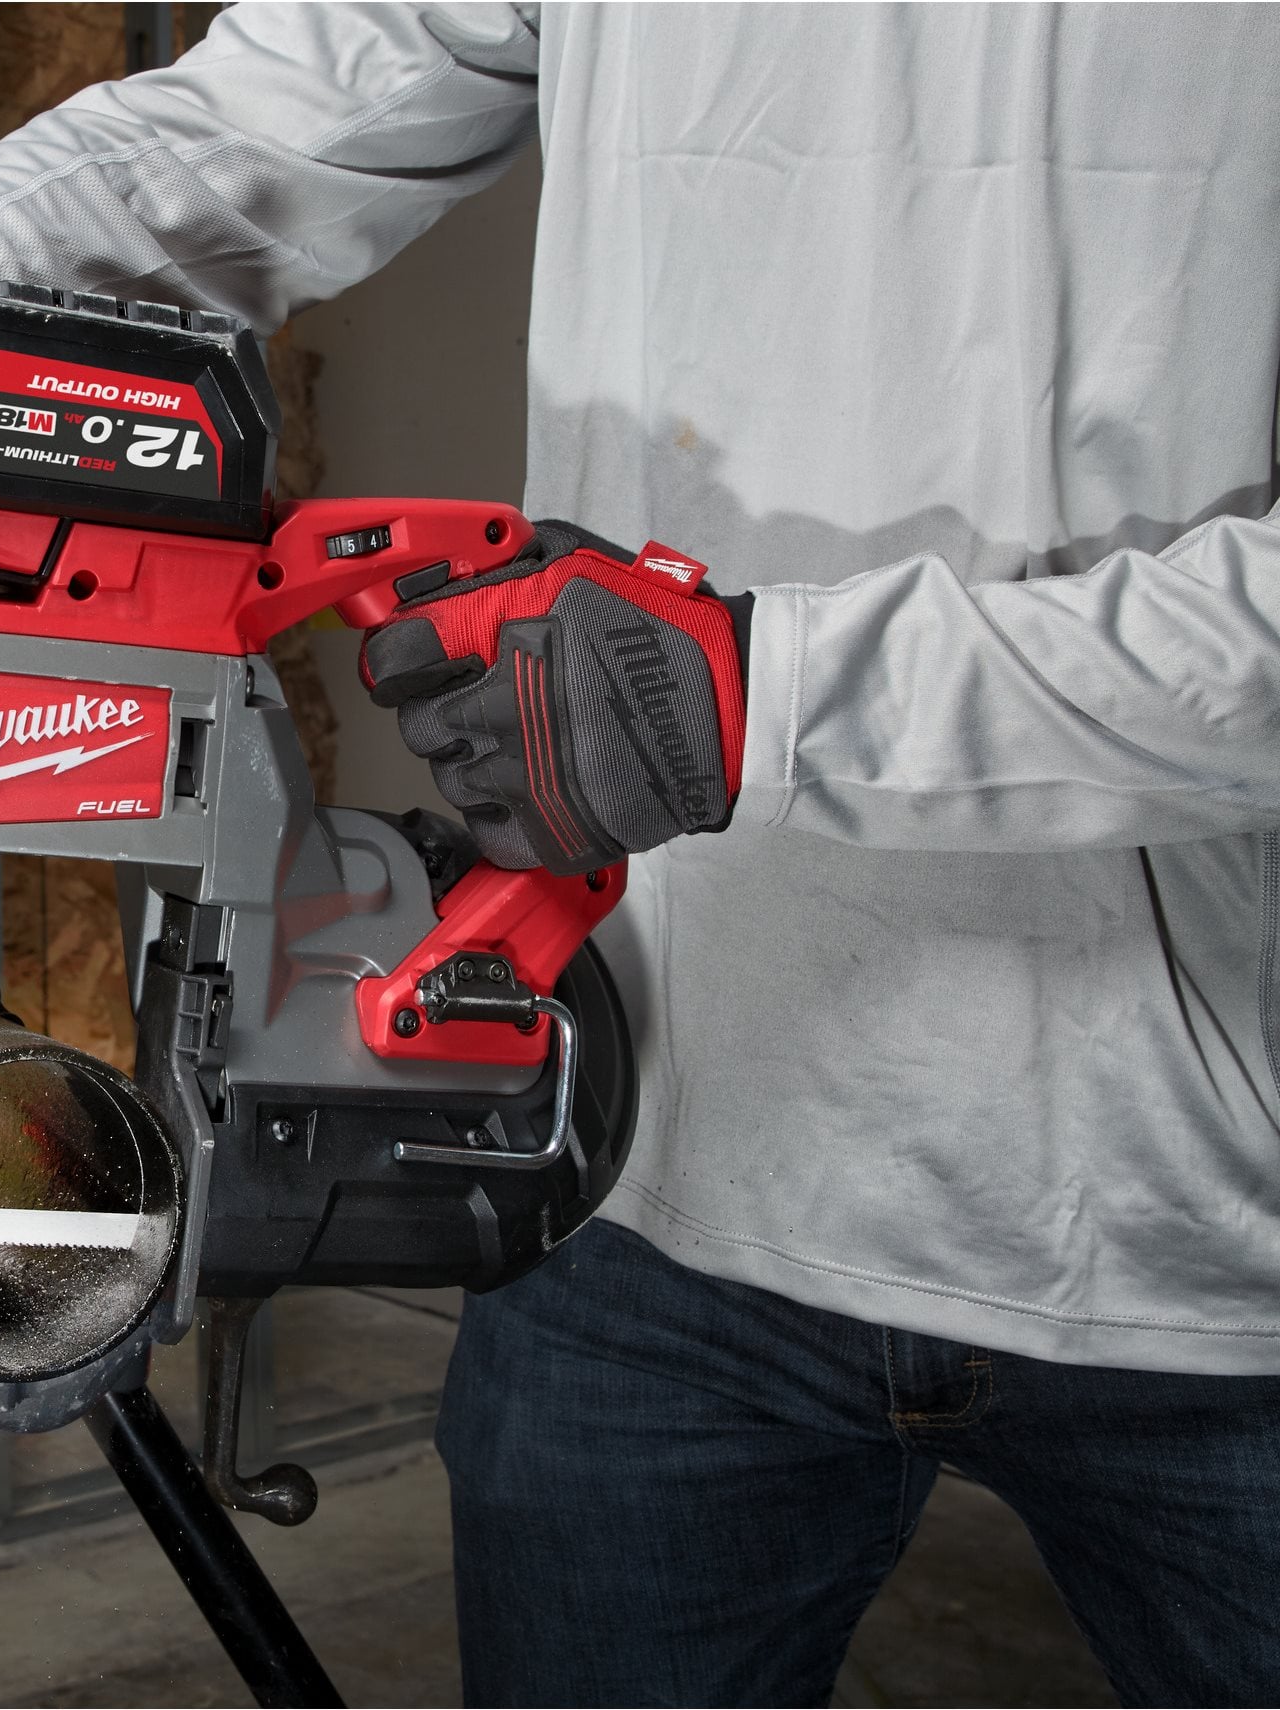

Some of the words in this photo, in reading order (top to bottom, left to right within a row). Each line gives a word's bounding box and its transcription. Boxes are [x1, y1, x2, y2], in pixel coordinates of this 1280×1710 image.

[27, 374, 120, 402] OUTPUT
[123, 388, 181, 410] HIGH
[347, 539, 355, 553] 5
[370, 534, 377, 548] 4
[644, 561, 692, 584] Milwaukee
[76, 799, 151, 815] FUEL
